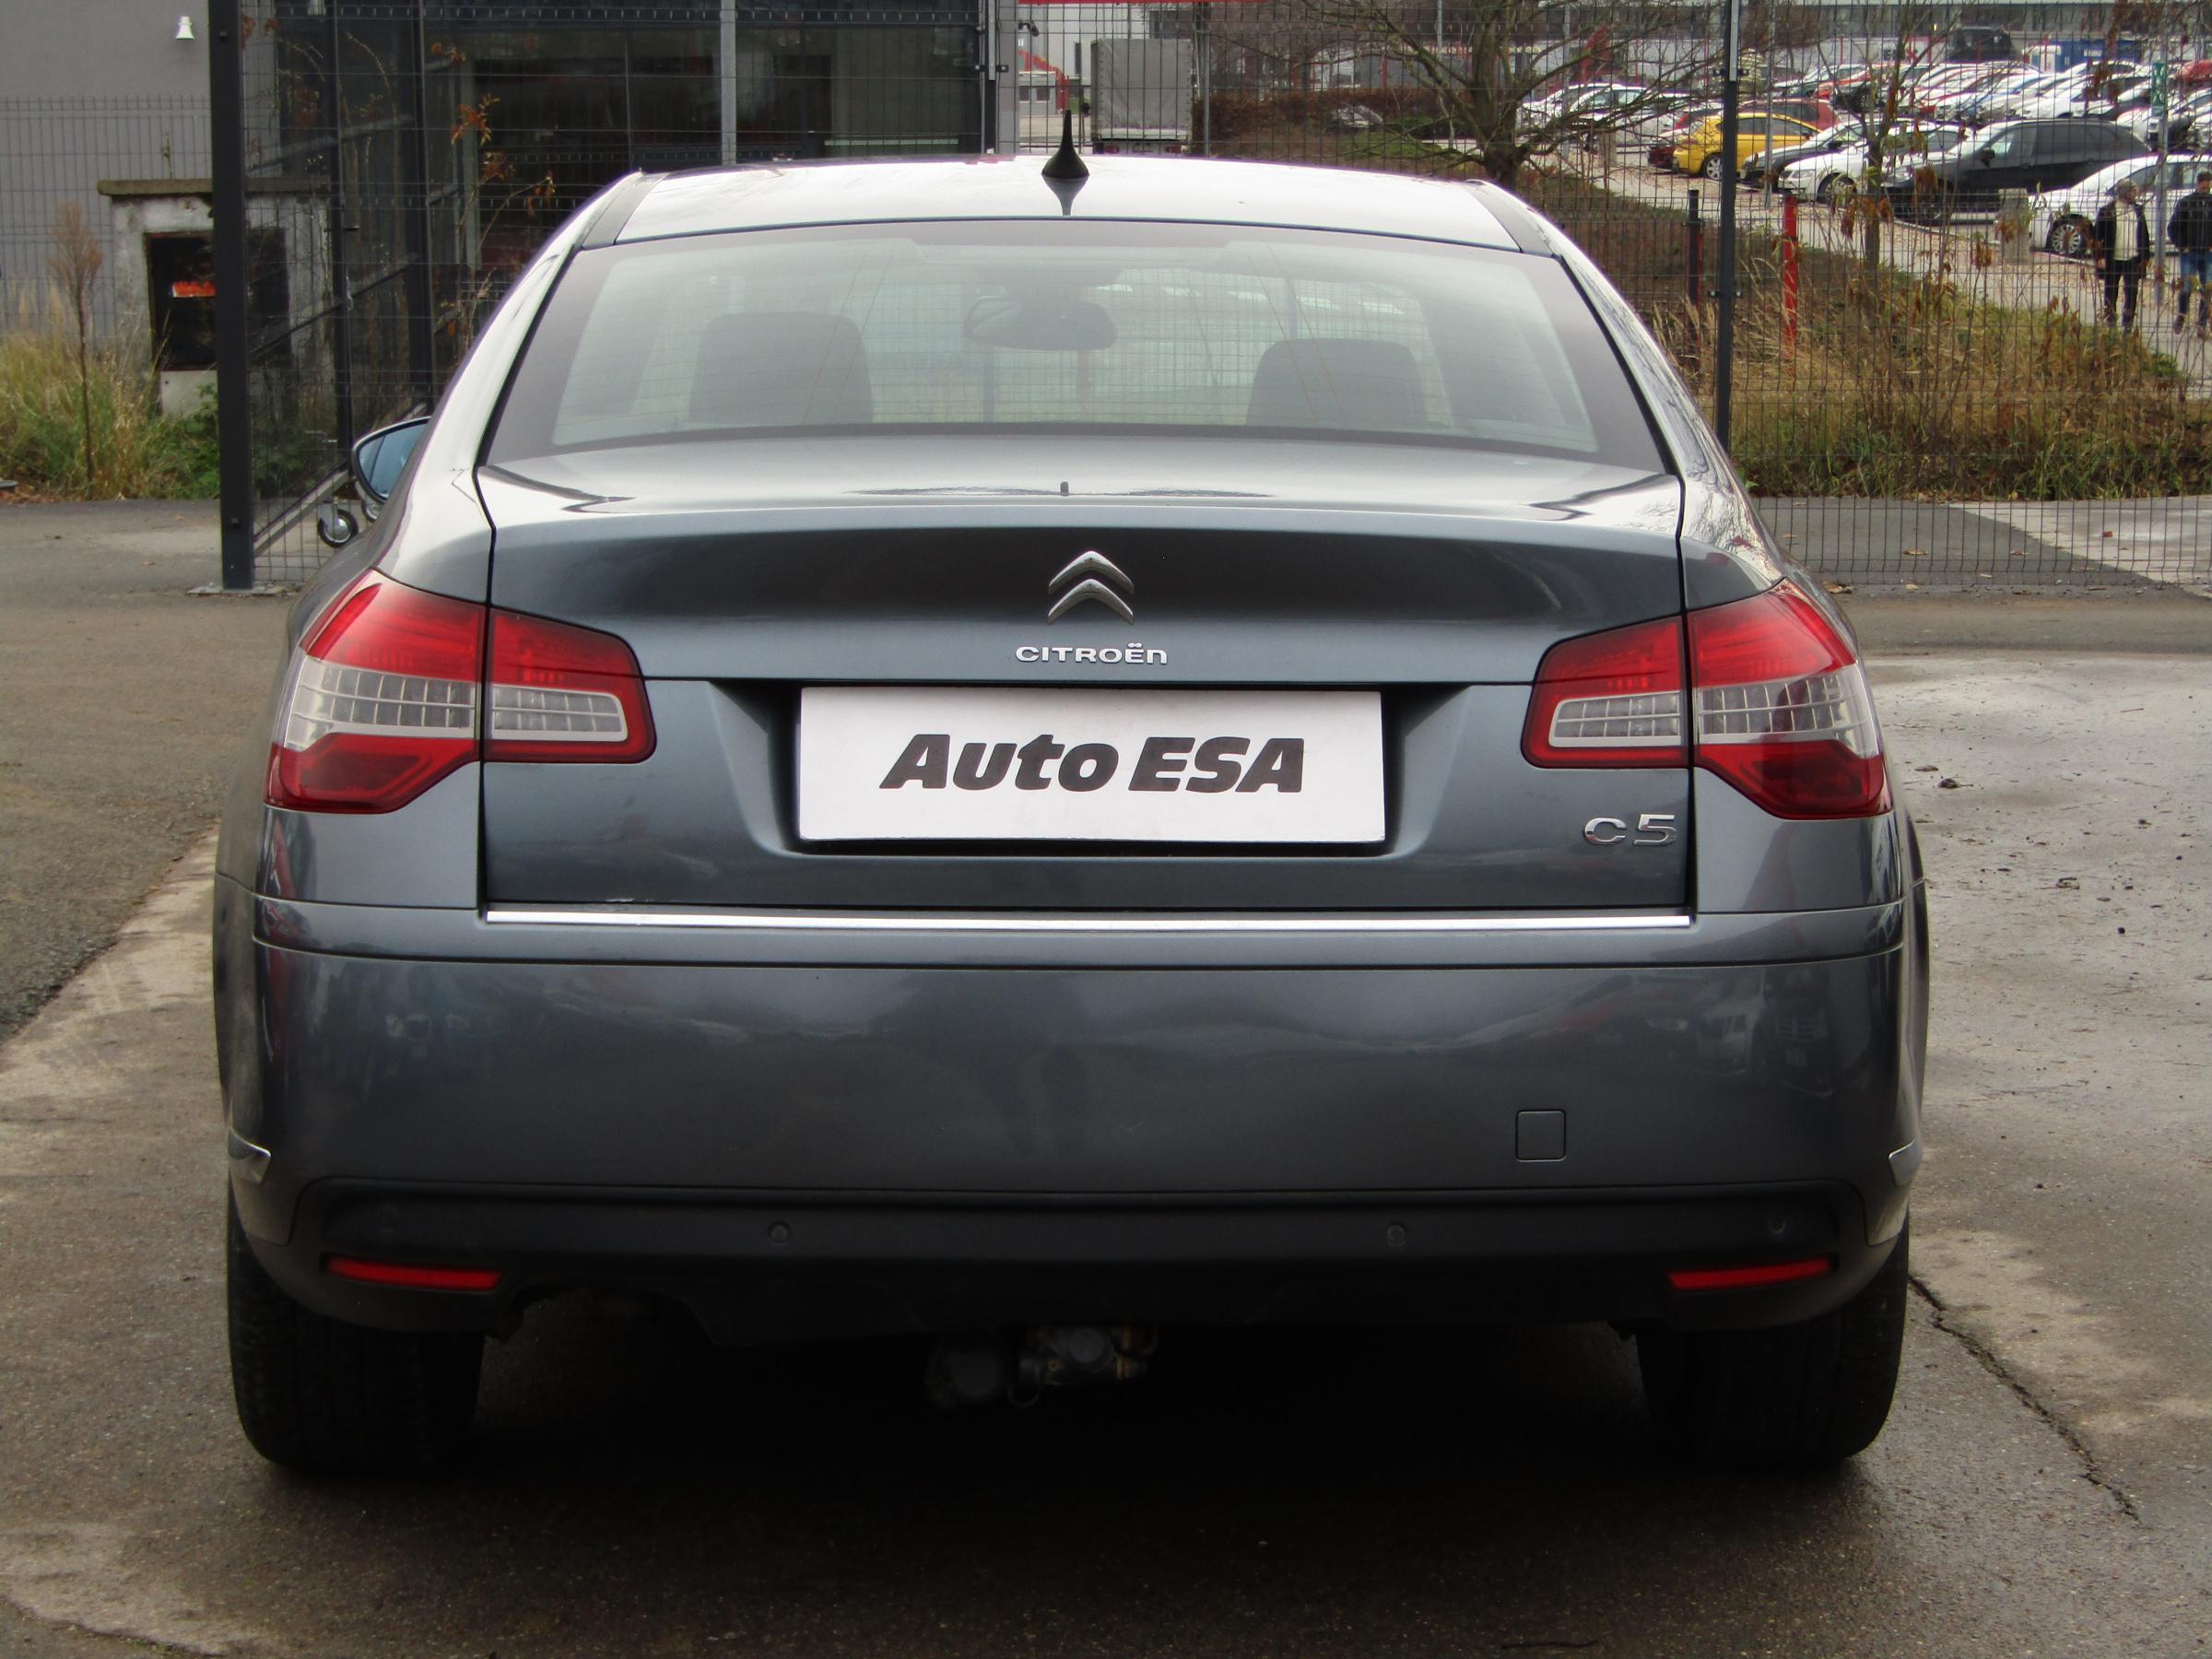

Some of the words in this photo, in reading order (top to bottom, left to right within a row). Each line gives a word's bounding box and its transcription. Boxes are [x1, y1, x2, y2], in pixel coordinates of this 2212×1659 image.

[879, 734, 1119, 792] Auto
[1128, 736, 1305, 793] ESA
[1583, 813, 1678, 846] C5
